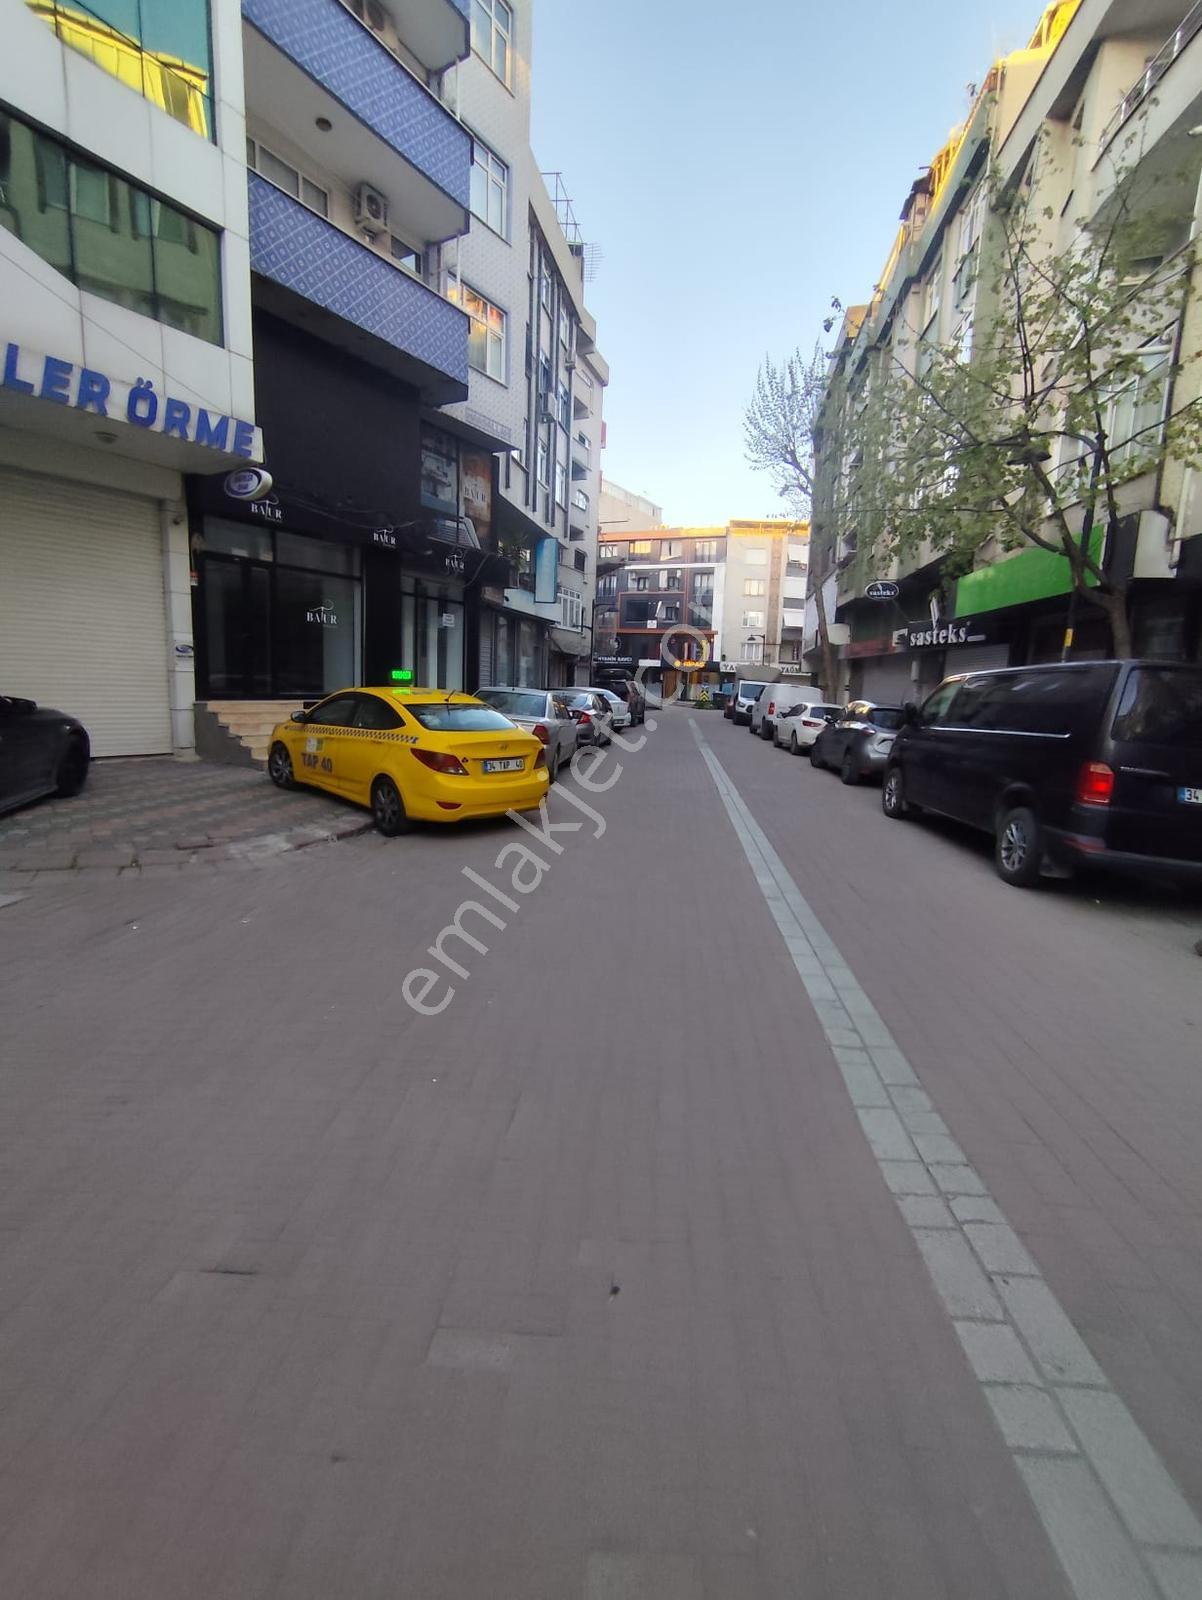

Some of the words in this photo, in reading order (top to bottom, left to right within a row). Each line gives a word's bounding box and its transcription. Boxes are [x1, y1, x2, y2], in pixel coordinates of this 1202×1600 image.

[3, 343, 111, 416] LER
[127, 377, 255, 457] ÖRME
[910, 618, 967, 647] sasteks
[301, 752, 318, 768] TAP
[321, 756, 333, 773] 40
